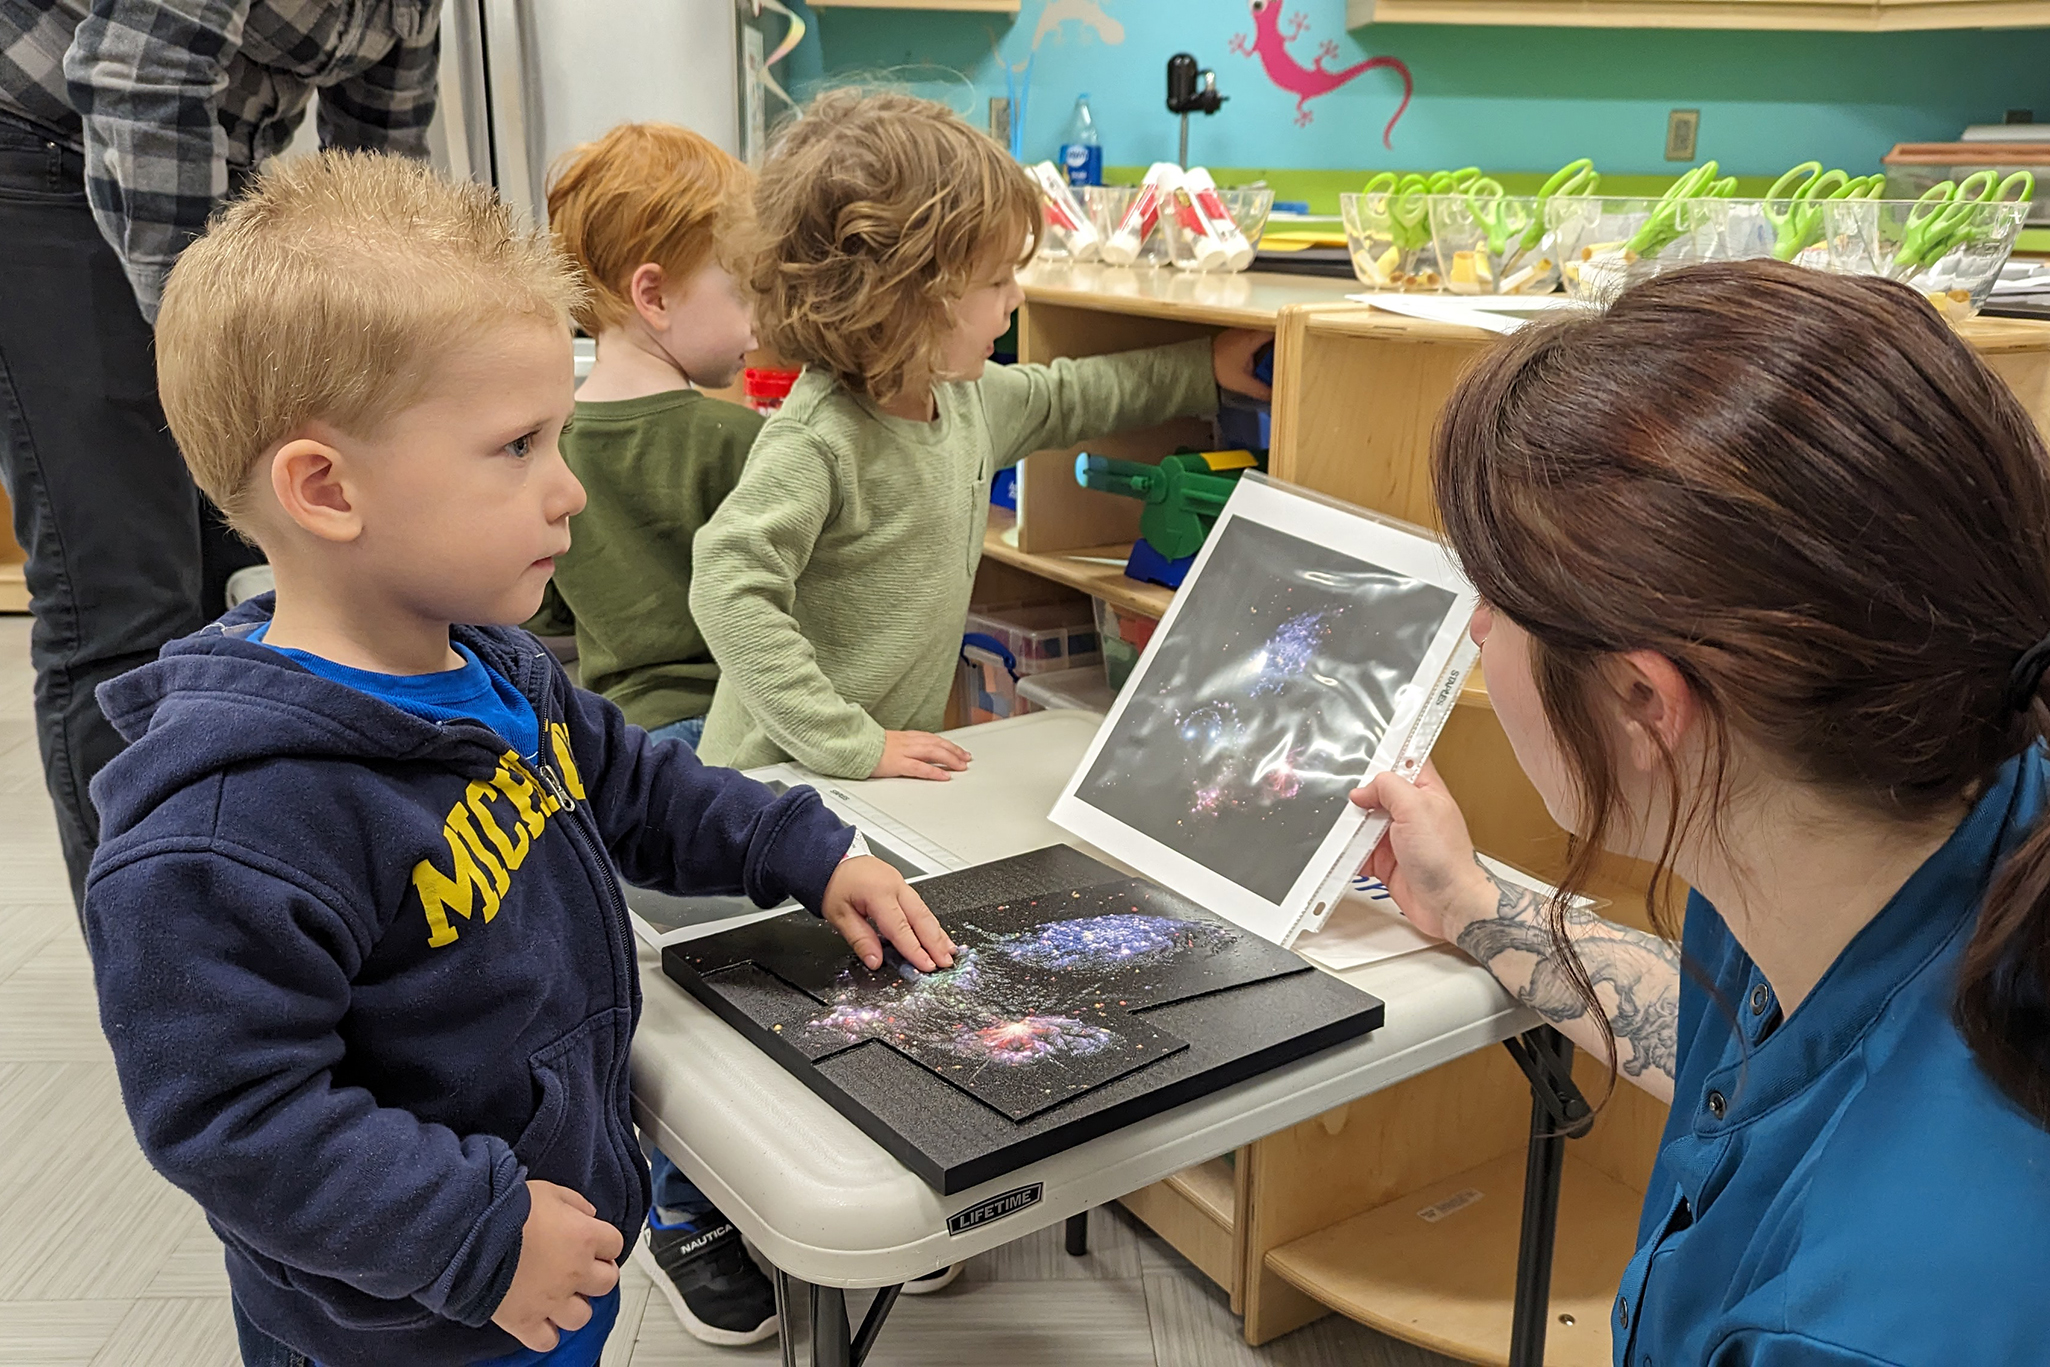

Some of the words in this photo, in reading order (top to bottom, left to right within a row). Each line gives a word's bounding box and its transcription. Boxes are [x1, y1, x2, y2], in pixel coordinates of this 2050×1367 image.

[1435, 669, 1460, 706] STAPLES
[960, 1190, 1031, 1228] LIFETIME
[680, 1223, 733, 1255] NAUTICA
